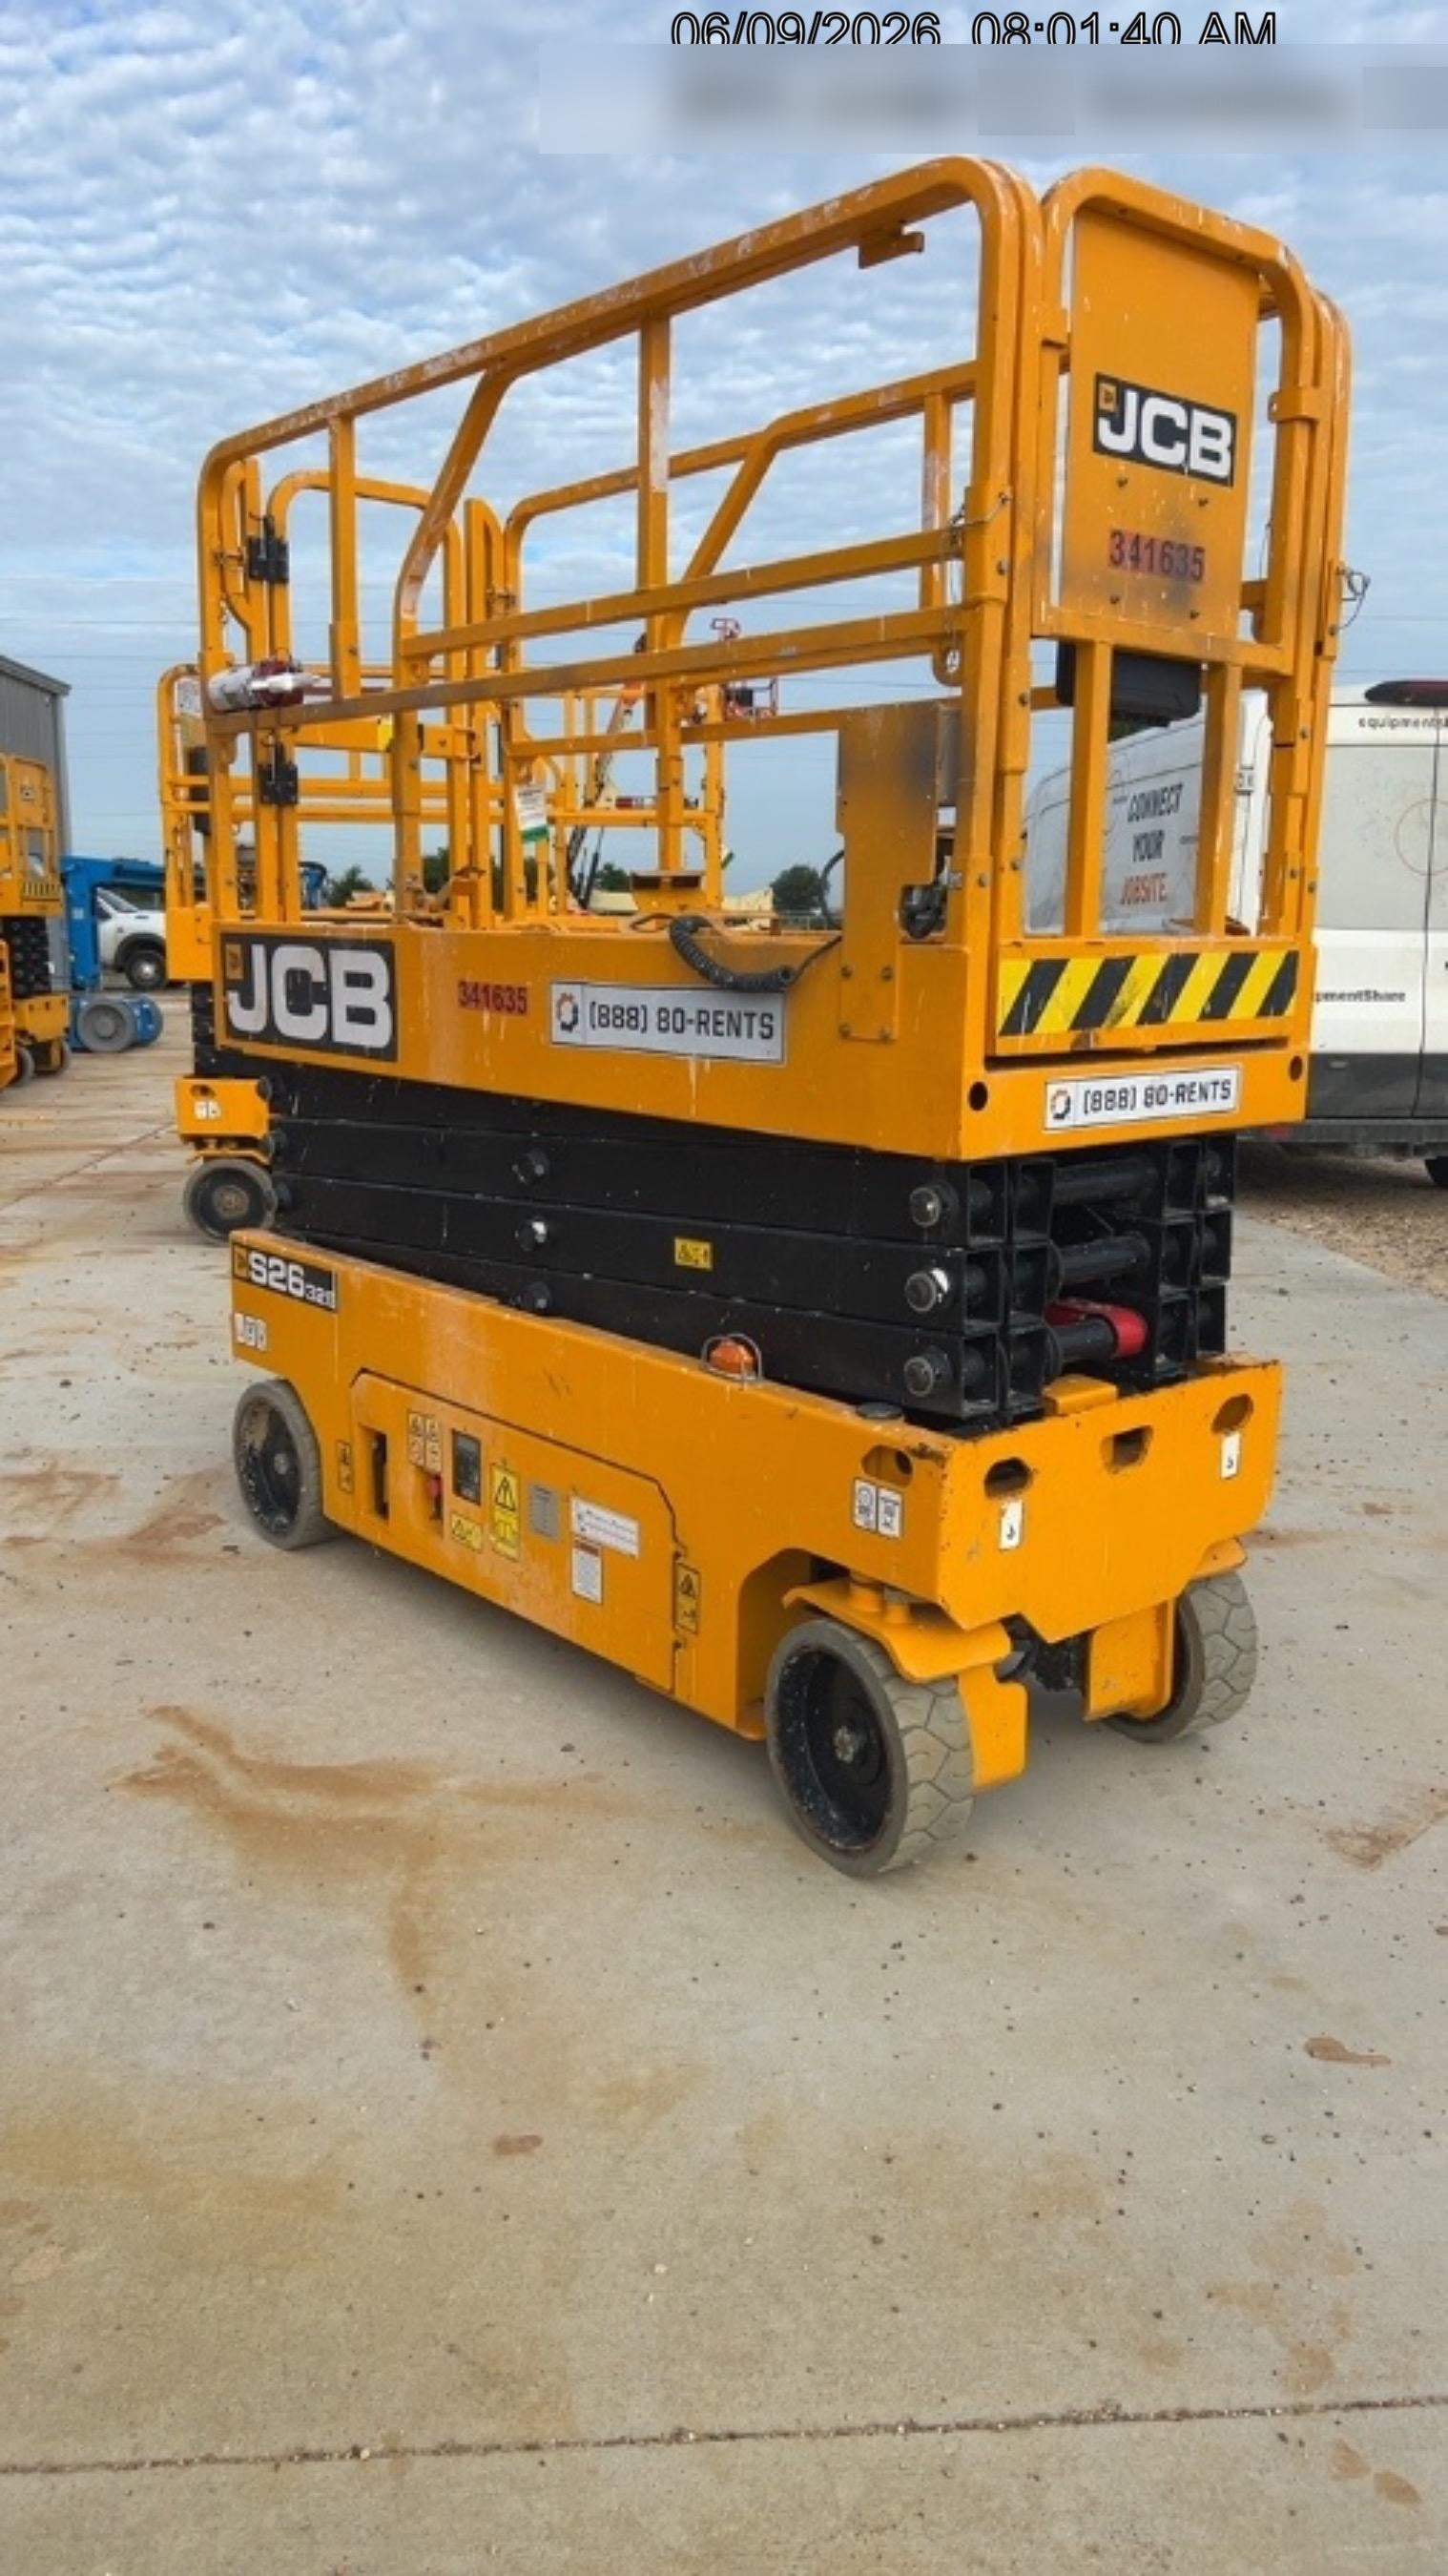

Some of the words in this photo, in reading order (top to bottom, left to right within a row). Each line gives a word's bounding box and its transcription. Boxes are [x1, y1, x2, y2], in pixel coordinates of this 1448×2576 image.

[1098, 389, 1232, 478] JCB
[1109, 529, 1206, 583] 341635
[227, 944, 393, 1049] JCB
[459, 981, 527, 1015] 341635
[657, 1006, 775, 1041] 80-RENTS
[1145, 1079, 1231, 1110] 80-RENTS
